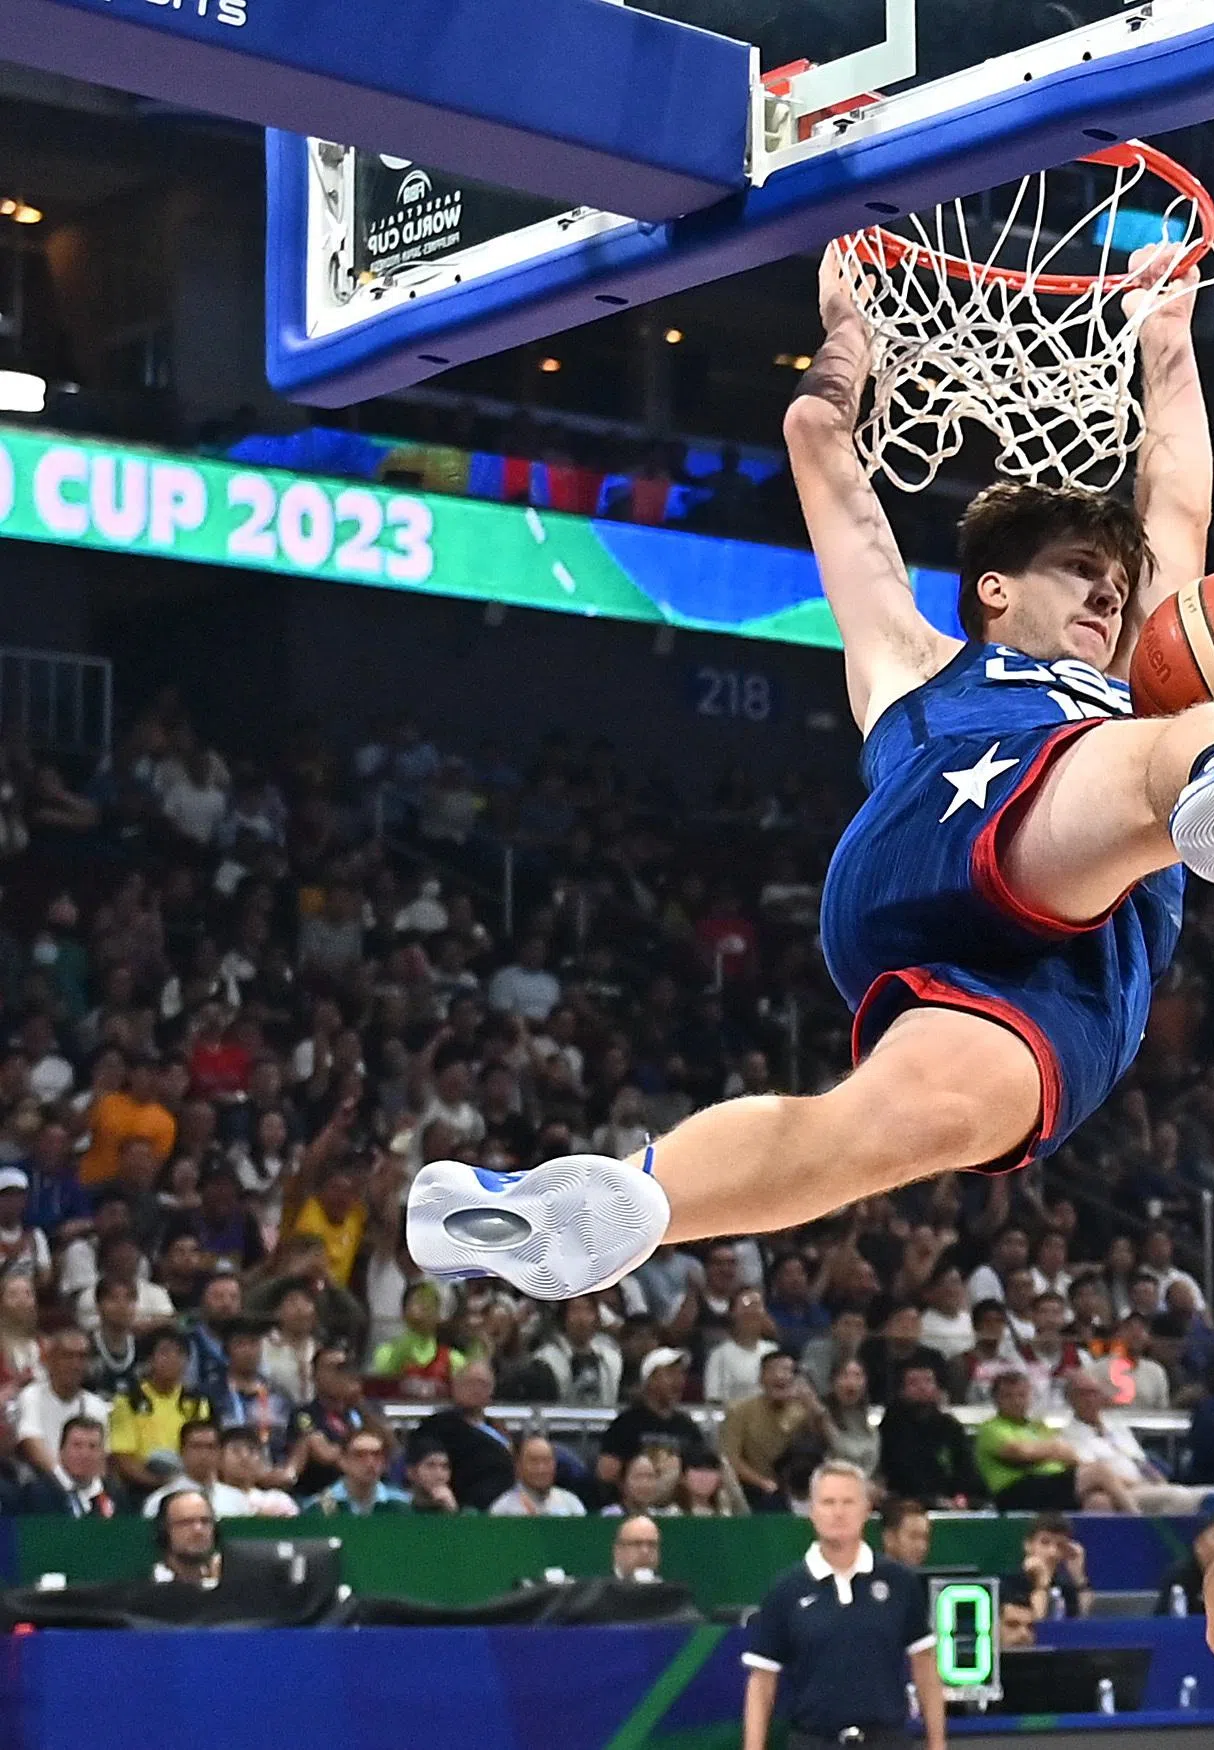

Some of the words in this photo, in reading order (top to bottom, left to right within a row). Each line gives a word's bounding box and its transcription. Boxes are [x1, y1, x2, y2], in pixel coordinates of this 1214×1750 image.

[34, 447, 208, 546] CUP
[227, 472, 434, 585] 2023
[696, 665, 771, 721] 218
[937, 1584, 992, 1686] 0
